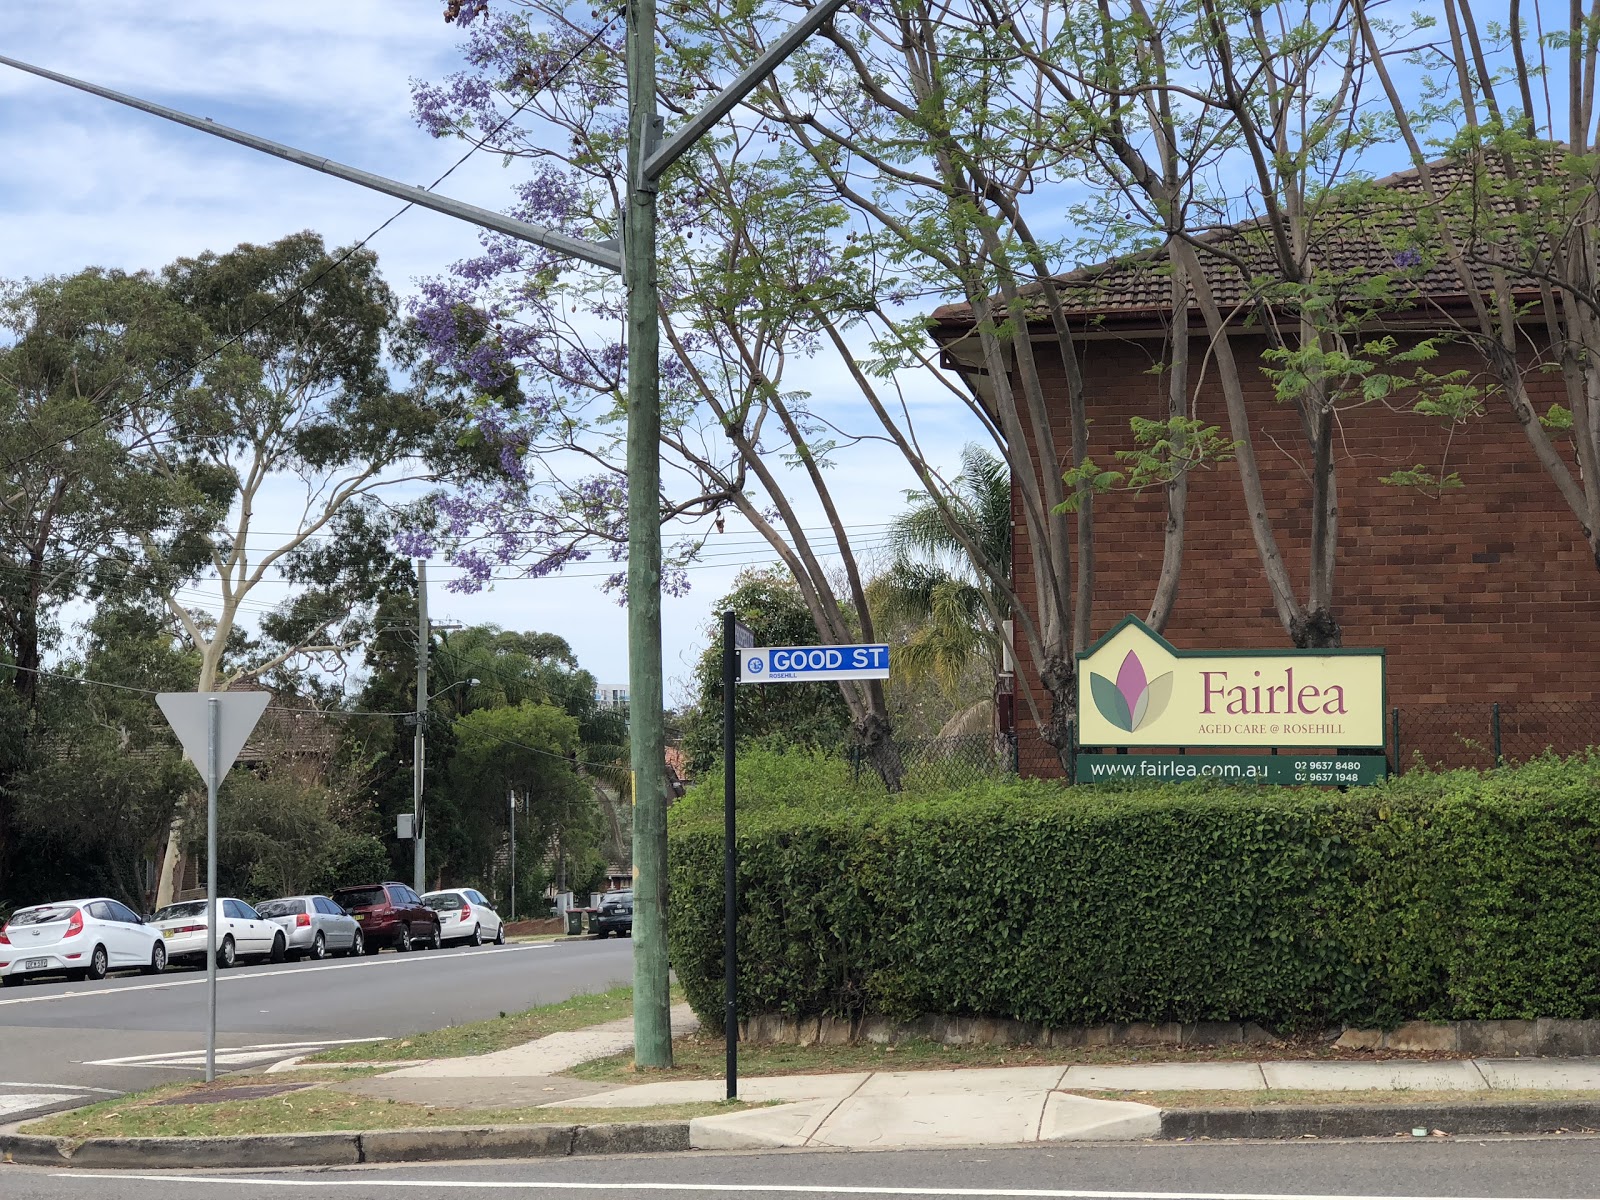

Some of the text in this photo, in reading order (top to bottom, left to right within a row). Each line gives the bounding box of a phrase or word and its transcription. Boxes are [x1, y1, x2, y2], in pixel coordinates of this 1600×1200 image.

[774, 648, 884, 670] GOOD ST
[1199, 667, 1348, 715] Fairlea
[1198, 724, 1345, 734] AGED CARE @ ROSEHILL
[1090, 760, 1268, 778] www.fairlea.com.au
[1294, 762, 1361, 770] 02 9637 8480
[1294, 773, 1358, 781] 02 9637 1948
